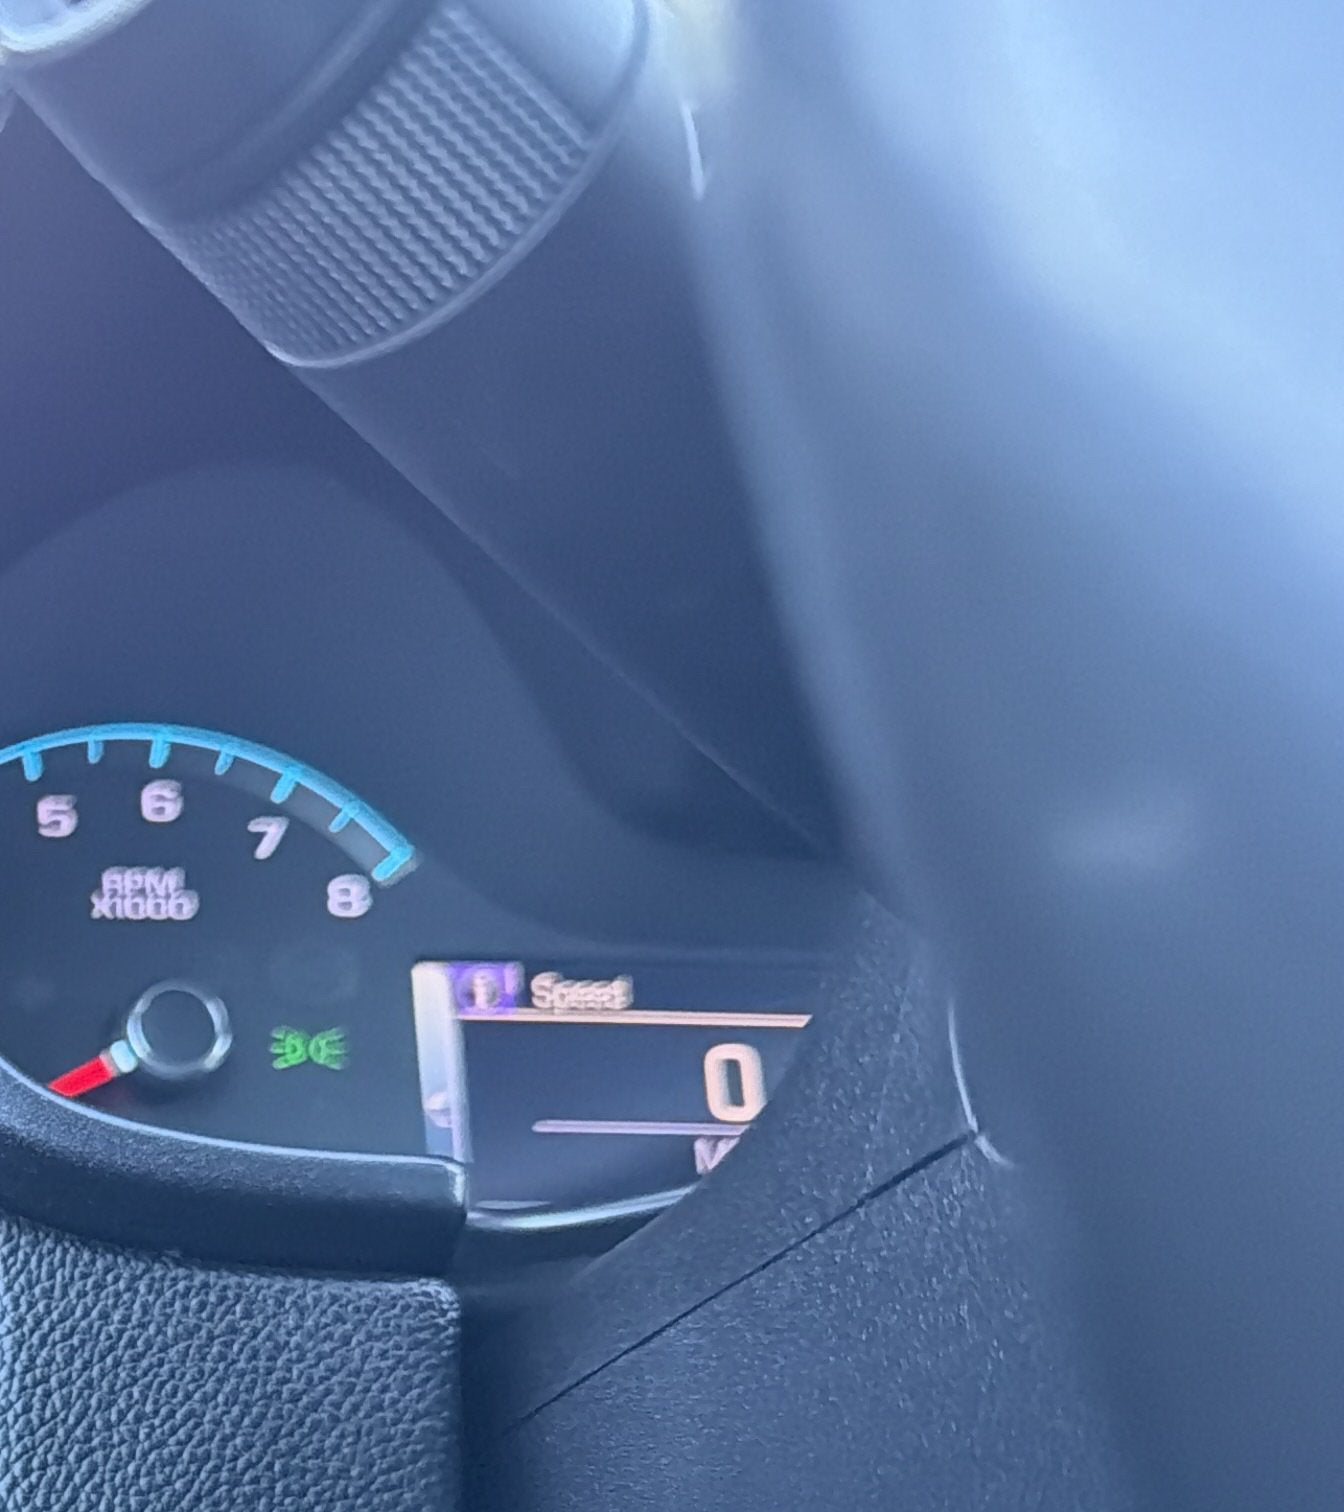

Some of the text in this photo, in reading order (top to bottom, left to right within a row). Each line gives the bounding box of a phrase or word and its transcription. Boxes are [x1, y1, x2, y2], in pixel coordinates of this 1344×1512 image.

[36, 794, 78, 838] 5
[140, 778, 184, 823] 6
[247, 815, 290, 860] 7
[101, 866, 186, 896] RPM
[326, 873, 373, 919] 8
[530, 971, 633, 1014] Speed
[703, 1043, 766, 1123] 0
